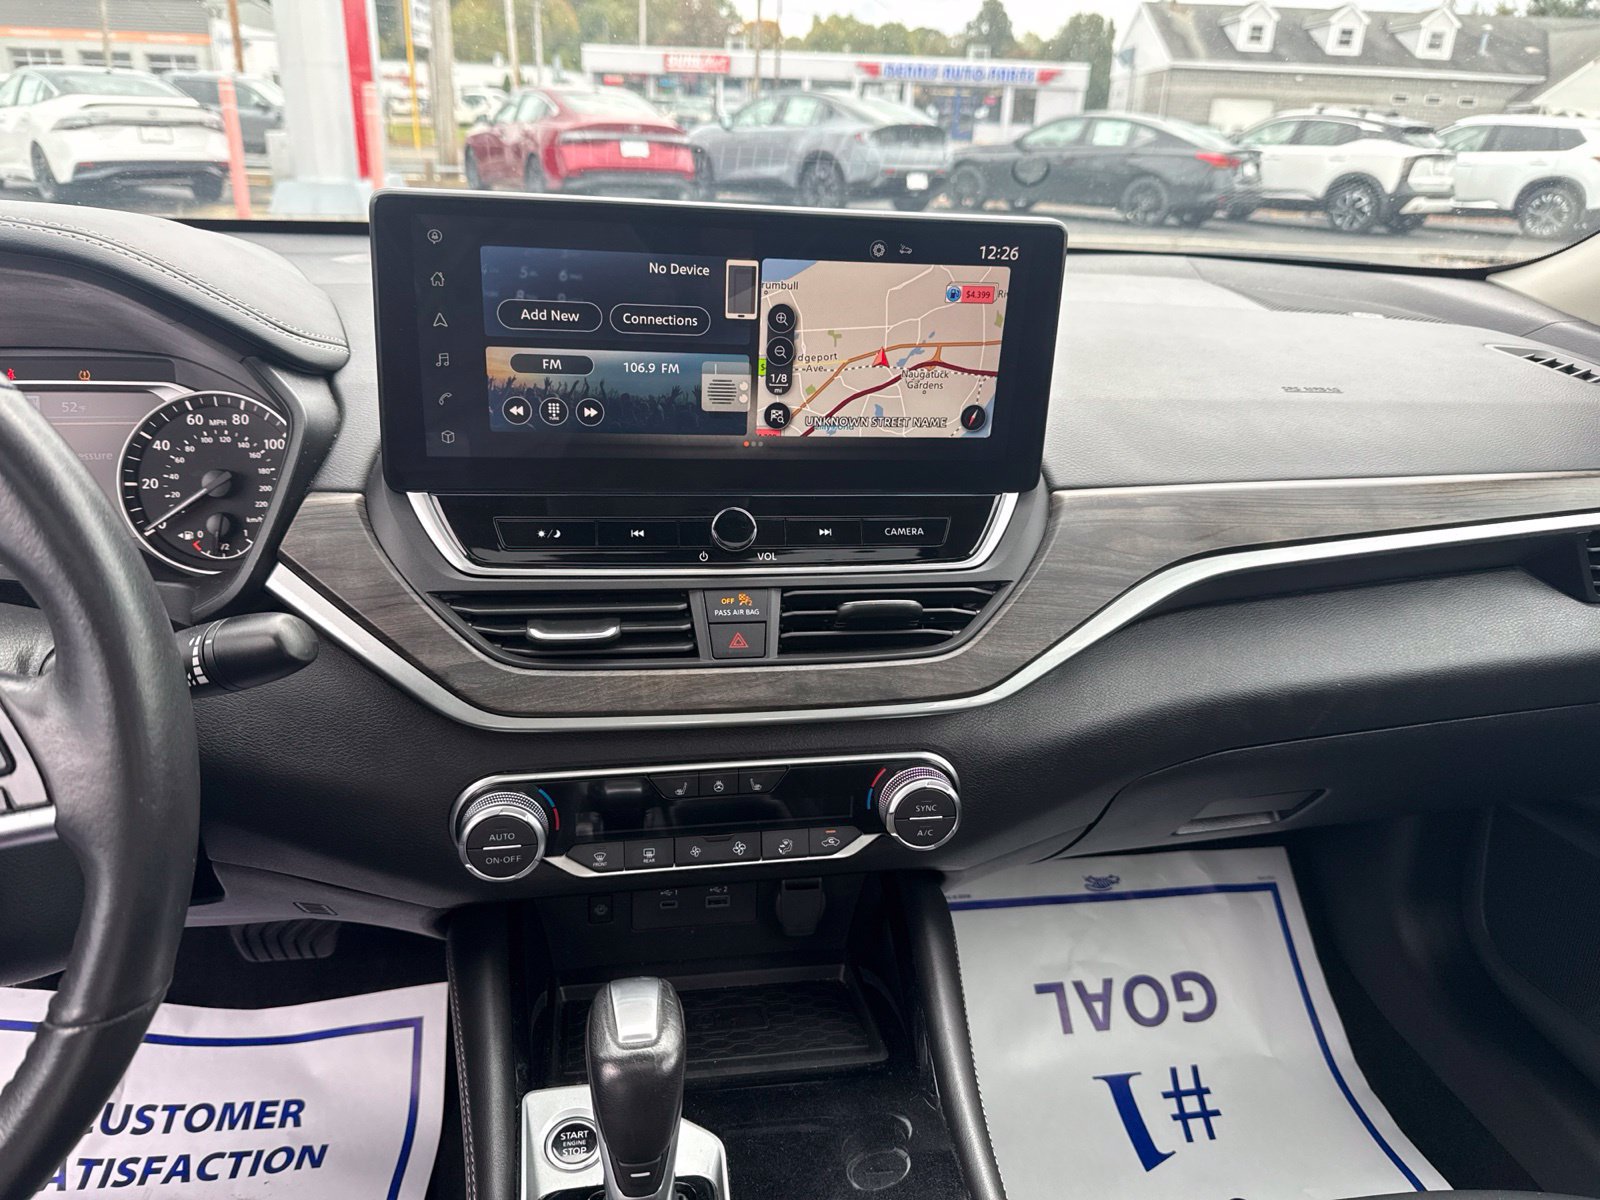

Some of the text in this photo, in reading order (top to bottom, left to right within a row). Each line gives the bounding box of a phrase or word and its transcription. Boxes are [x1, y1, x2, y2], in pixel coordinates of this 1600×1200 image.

[979, 245, 1020, 261] 12:26
[649, 262, 710, 277] No Device
[965, 290, 991, 299] $4.399
[520, 308, 580, 323] Add New
[622, 312, 699, 327] Connections
[541, 358, 563, 371] FM
[623, 361, 681, 375] 106.9 FM
[805, 365, 824, 373] Ave
[770, 373, 788, 384] 1/8
[901, 370, 949, 381] Naugatuck
[906, 381, 944, 390] Gardens
[186, 414, 204, 426] 60
[208, 419, 228, 427] MPH
[231, 414, 250, 426] 80
[804, 415, 869, 428] UNKNOWN
[870, 416, 911, 428] STREET
[911, 417, 948, 429] NAME
[152, 439, 171, 451] 40
[263, 438, 286, 450] 100
[141, 478, 160, 490] 20
[196, 530, 204, 539] 0
[883, 526, 925, 537] CAMERA
[756, 551, 778, 562] VOL
[721, 597, 735, 605] OFF
[745, 608, 760, 616] BAG
[915, 803, 938, 813] SYNC
[488, 832, 516, 842] AUTO
[916, 829, 934, 838] A/C
[1033, 970, 1218, 1035] GOAL
[88, 1099, 306, 1137] USTOMER
[1092, 1064, 1222, 1172] #1
[560, 1130, 589, 1141] START
[562, 1146, 587, 1157] STOP
